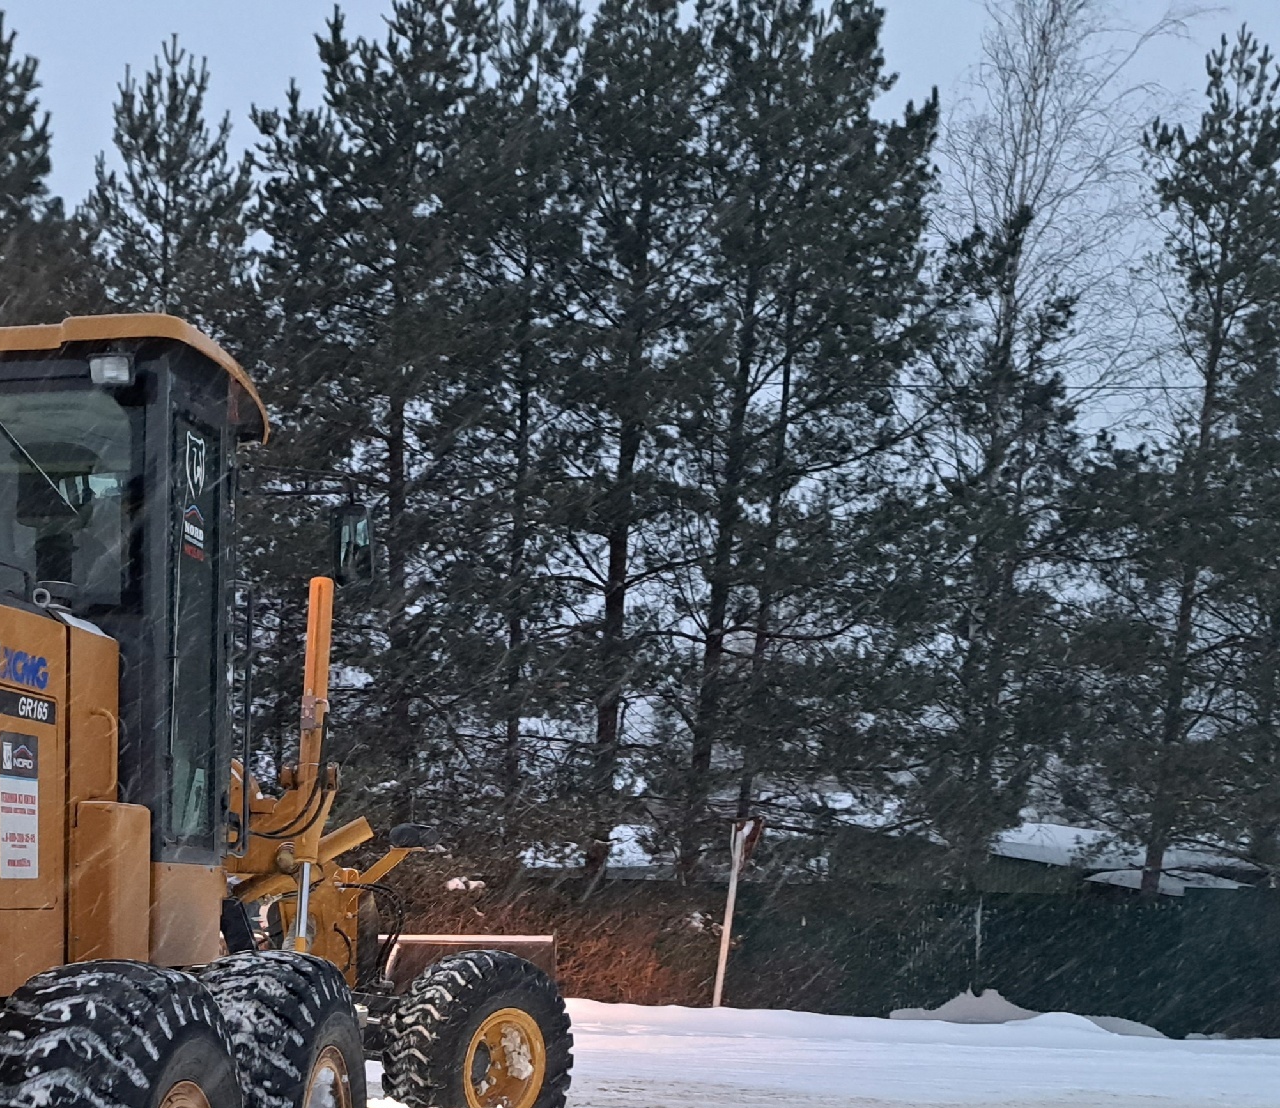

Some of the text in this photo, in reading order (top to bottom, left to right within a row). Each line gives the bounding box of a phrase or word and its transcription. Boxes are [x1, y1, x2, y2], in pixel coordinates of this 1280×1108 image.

[184, 520, 204, 542] NORD
[1, 646, 50, 690] XCMG
[18, 696, 49, 720] GR165
